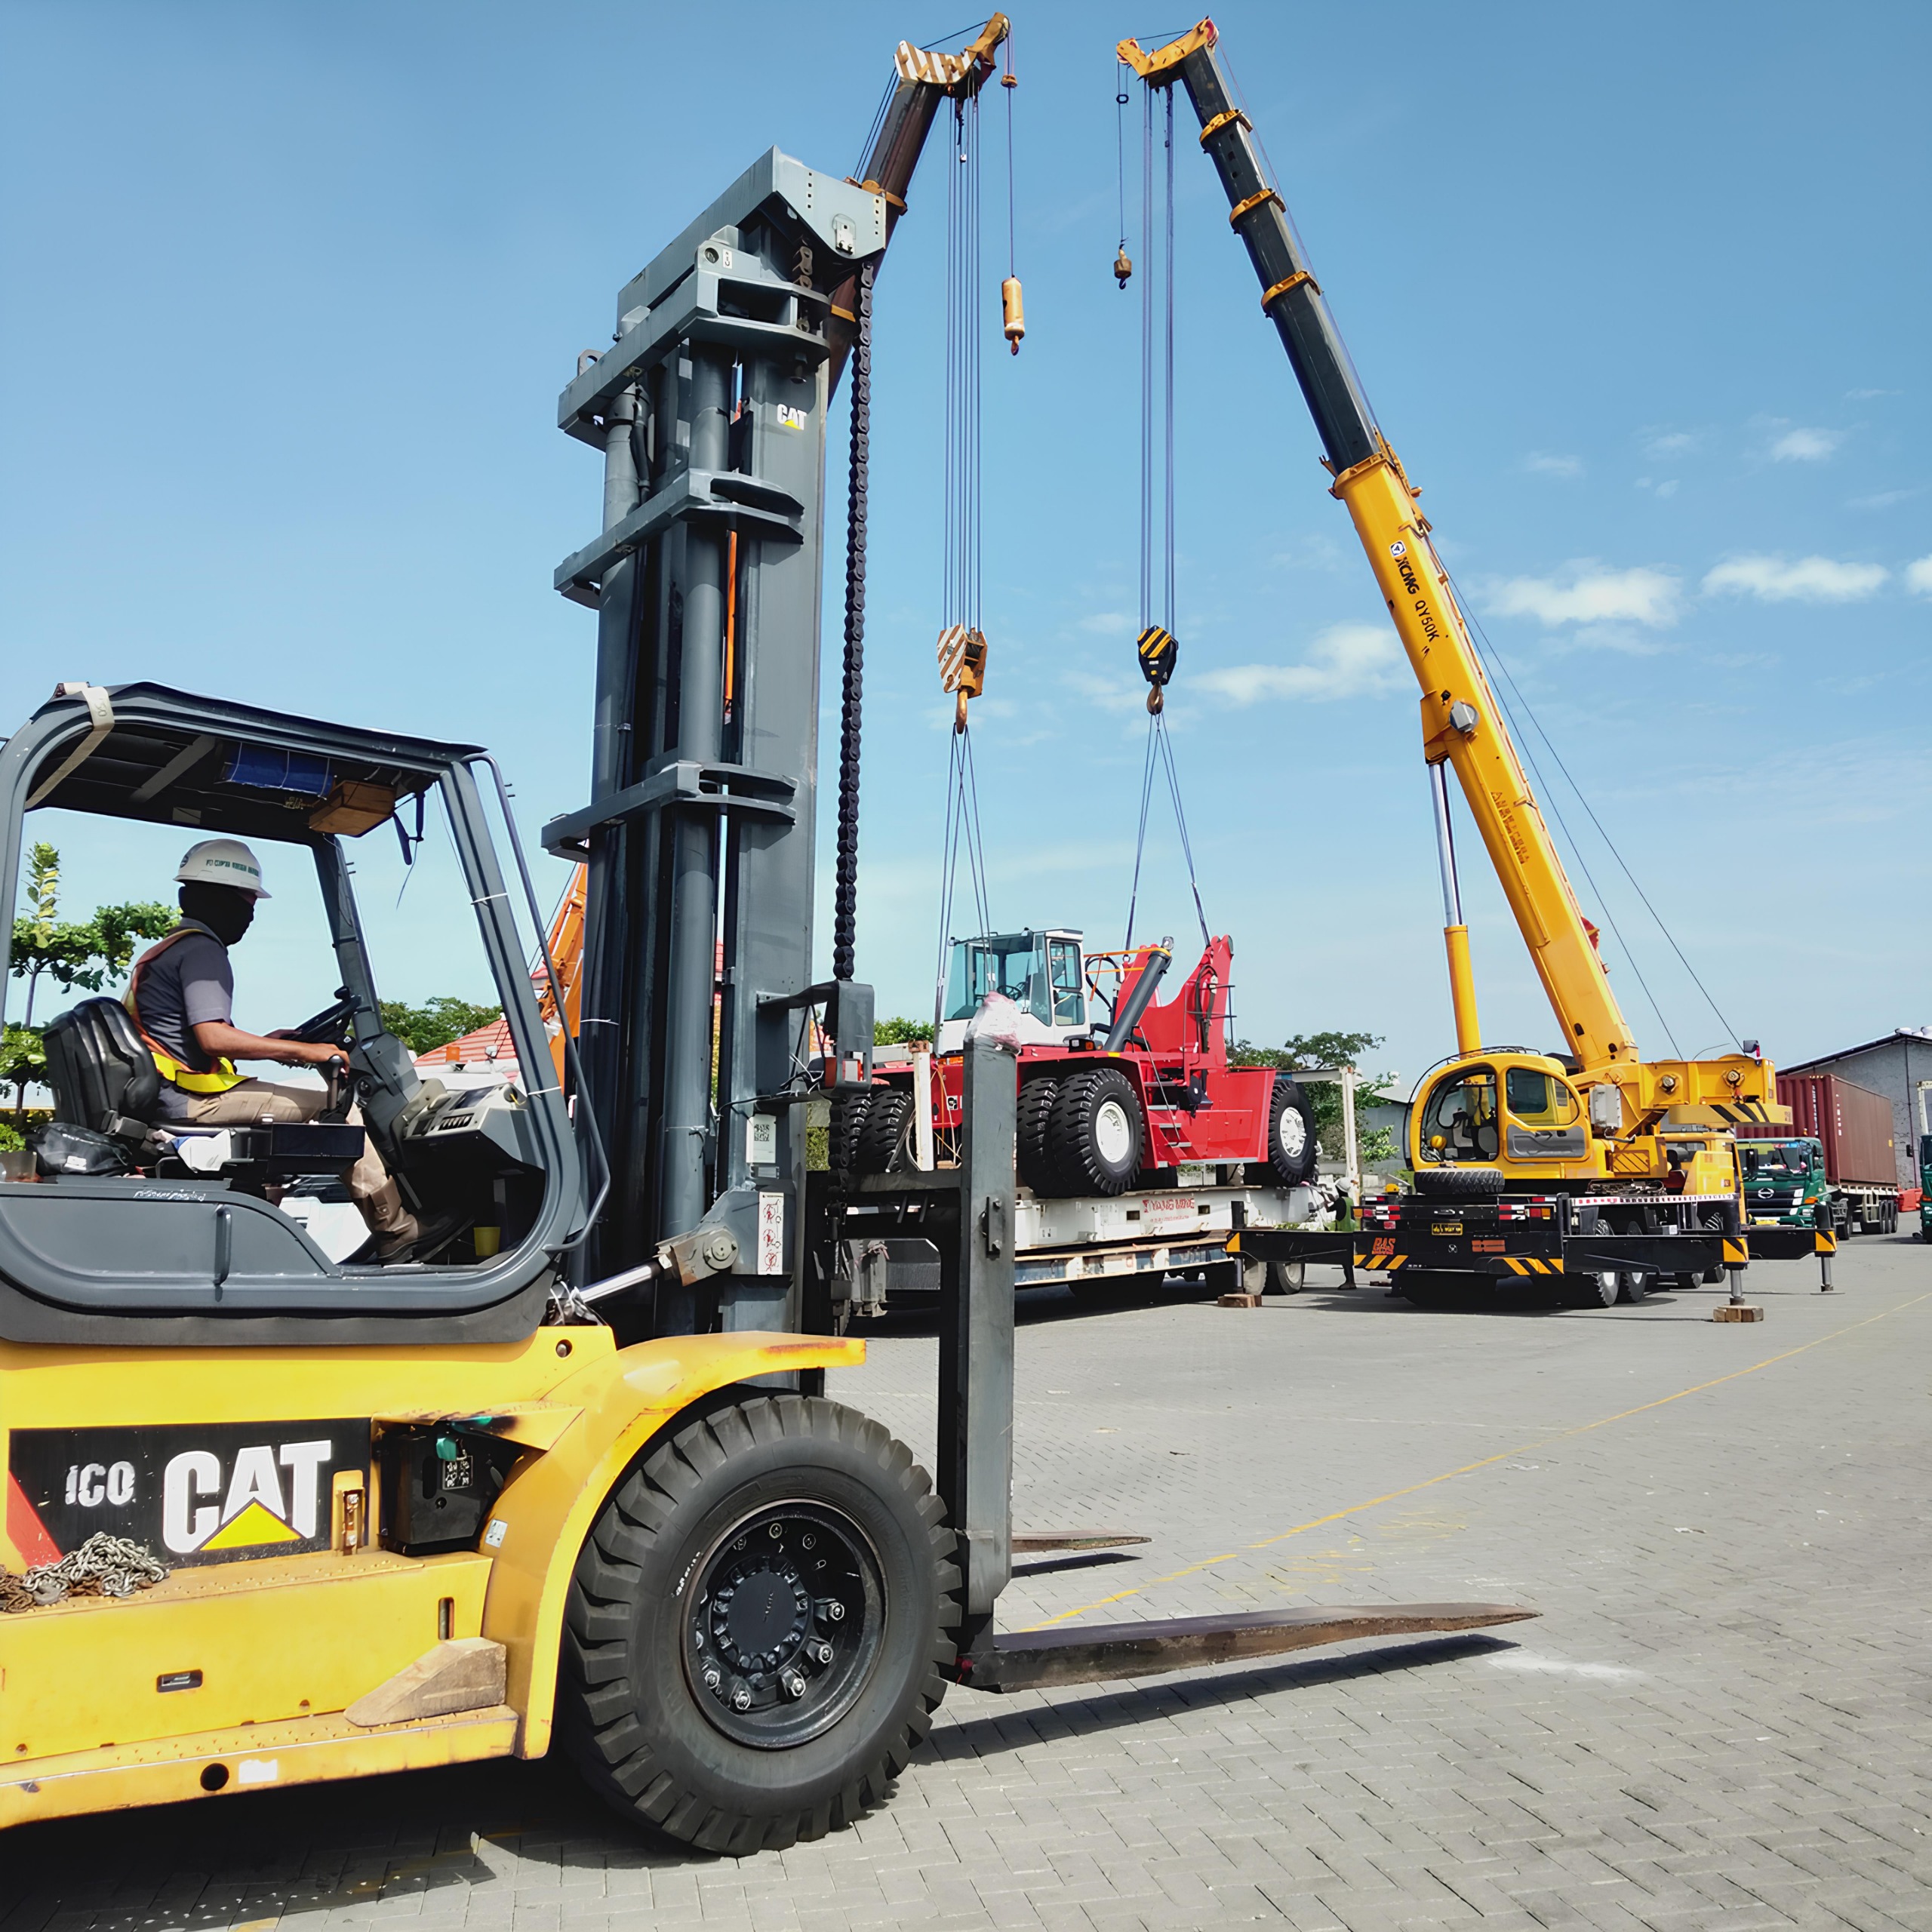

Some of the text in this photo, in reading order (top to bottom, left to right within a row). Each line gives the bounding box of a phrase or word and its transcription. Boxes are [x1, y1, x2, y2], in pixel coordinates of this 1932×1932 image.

[777, 404, 807, 430] CAT
[1415, 600, 1439, 642] QY50K
[163, 1439, 332, 1553] CAT
